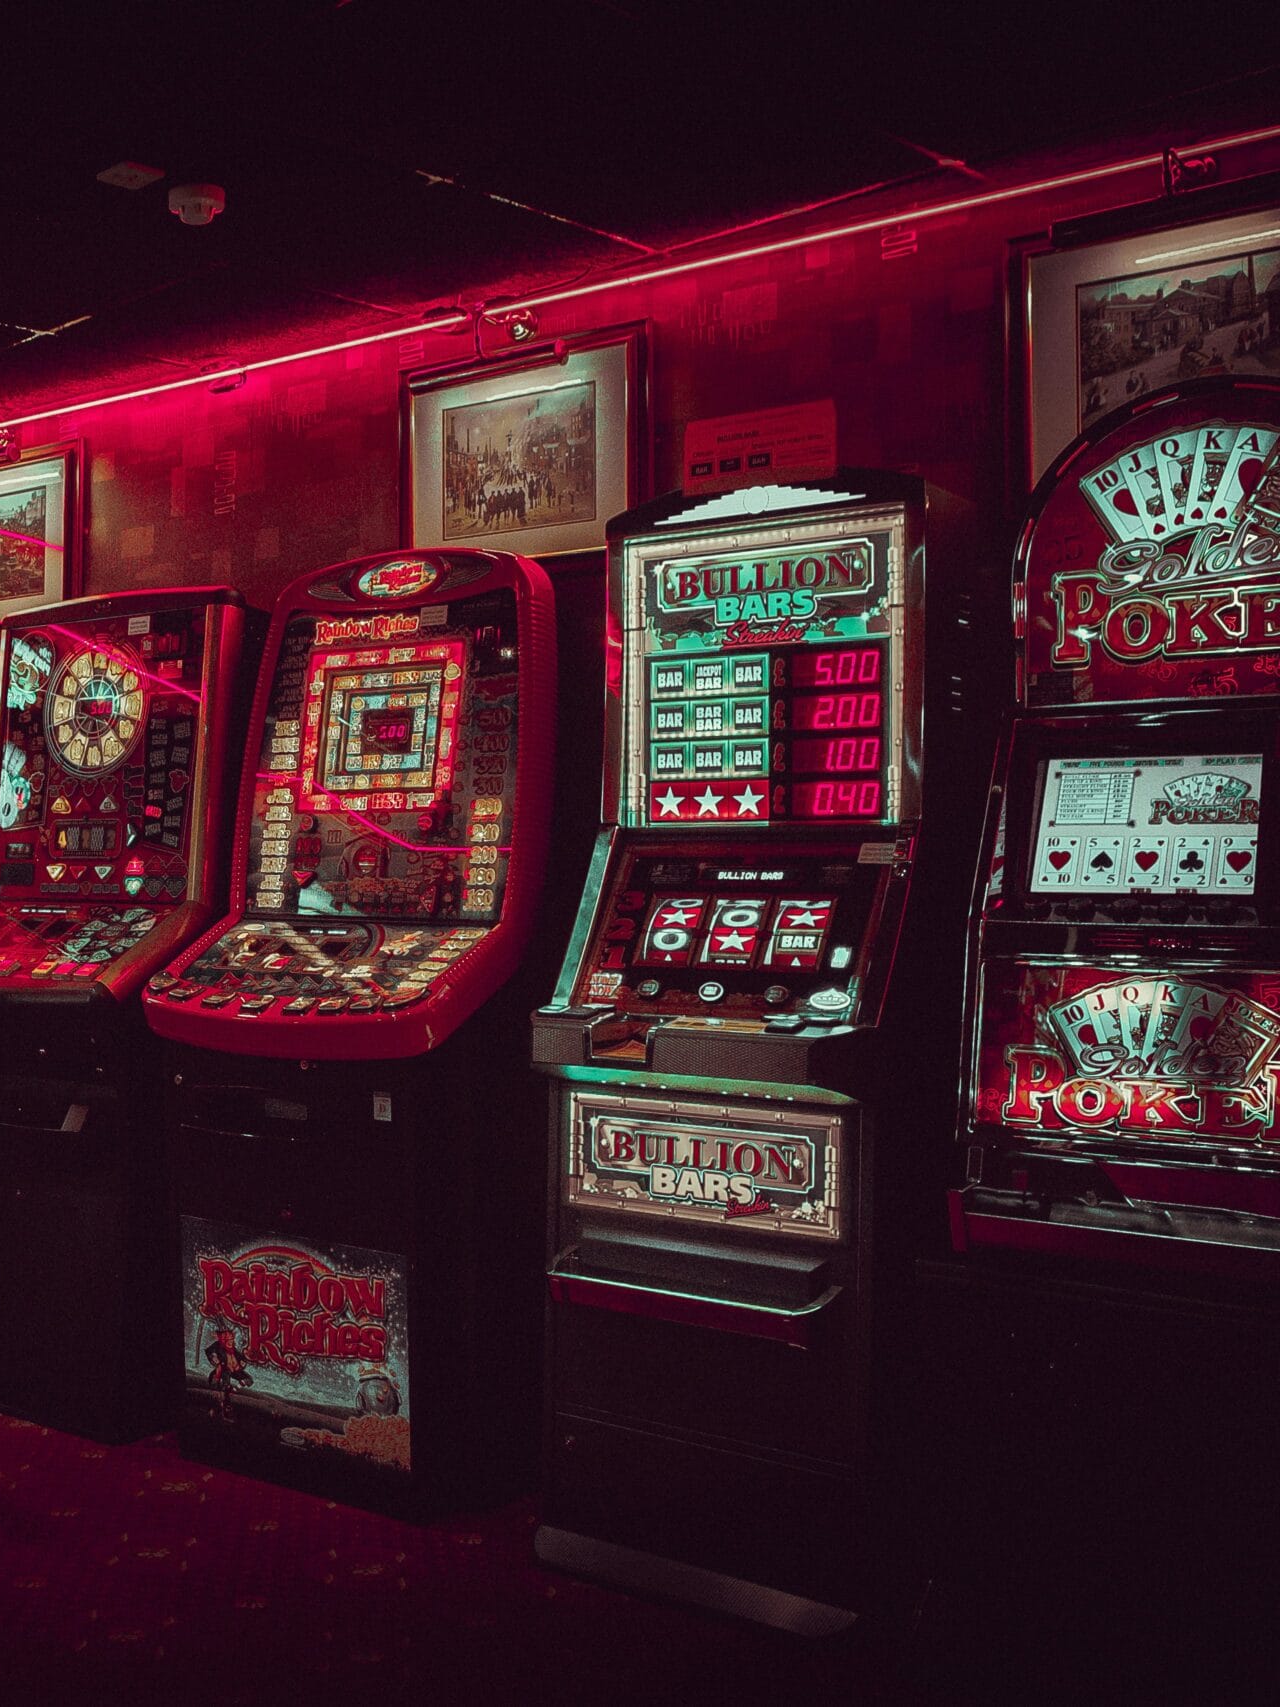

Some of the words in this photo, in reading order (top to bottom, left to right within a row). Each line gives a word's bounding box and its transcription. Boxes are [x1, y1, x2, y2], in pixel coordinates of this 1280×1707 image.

[1160, 438, 1180, 458] Q
[1204, 429, 1225, 450] K
[1236, 431, 1262, 452] A
[1127, 452, 1144, 474] J
[1091, 468, 1119, 494] 10
[675, 552, 861, 601] BULLION
[716, 588, 817, 624] BARS
[314, 617, 373, 645] Rainbow
[371, 613, 420, 640] Riches
[696, 664, 721, 677] JACKPOT
[735, 664, 761, 682] BAR
[814, 651, 880, 685] 5.00
[657, 672, 683, 689] BAR
[696, 678, 722, 690] BAR
[657, 712, 683, 730] BAR
[696, 705, 722, 718] BAR
[735, 705, 761, 724] BAR
[813, 694, 880, 729] 2.00
[696, 718, 722, 732] BAR
[657, 753, 683, 770] BAR
[696, 751, 722, 768] BAR
[735, 747, 761, 766] BAR
[825, 738, 880, 771] 1.00
[813, 782, 880, 815] 0.40
[1150, 797, 1261, 825] POKER
[1047, 837, 1060, 847] 10
[1089, 837, 1098, 848] 5
[1132, 837, 1141, 848] 2
[1177, 837, 1186, 848] 2
[1223, 837, 1233, 848] 9
[717, 871, 757, 881] BULLION
[760, 871, 785, 881] BARS
[780, 934, 816, 950] BAR
[1093, 994, 1106, 1011] J
[1122, 986, 1140, 1003] Q
[1162, 984, 1181, 1003] K
[1193, 993, 1211, 1012] A
[1060, 1004, 1085, 1025] 10
[1227, 1000, 1280, 1037] JOKER
[1076, 1041, 1250, 1080] Golden
[608, 1129, 798, 1183] BULLION
[650, 1165, 754, 1206] BARS
[198, 1255, 386, 1326] Rainbow
[242, 1301, 388, 1375] Riches
